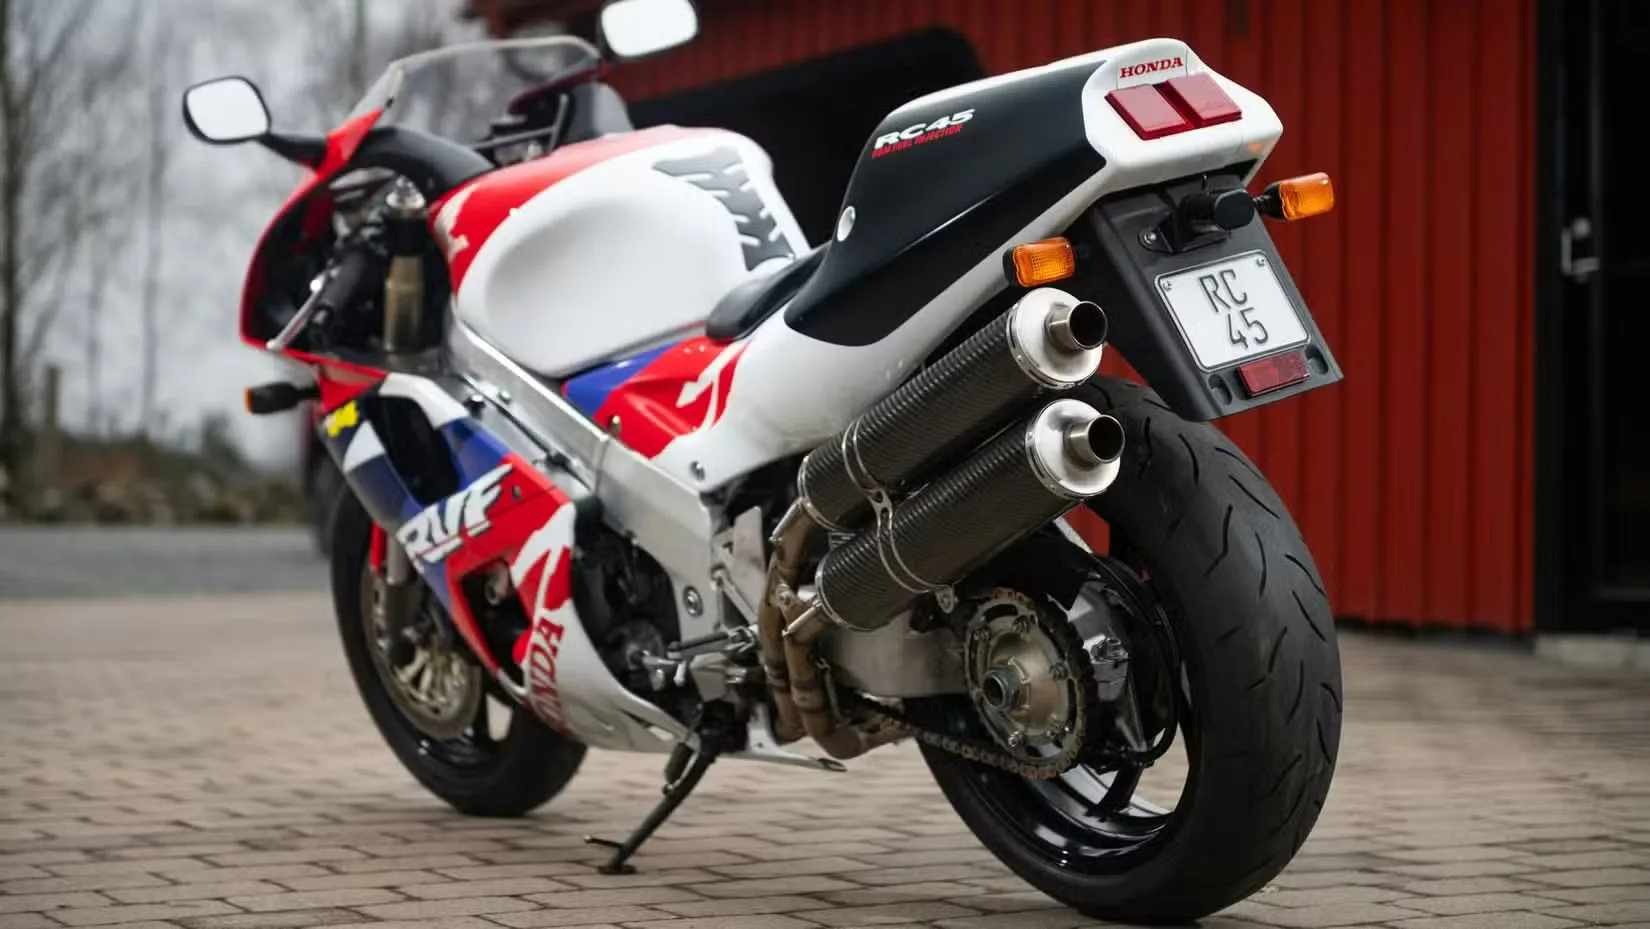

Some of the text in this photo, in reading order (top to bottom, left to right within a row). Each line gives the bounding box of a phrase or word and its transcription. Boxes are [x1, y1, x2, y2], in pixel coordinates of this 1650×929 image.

[1120, 57, 1183, 78] HONDA
[874, 108, 976, 150] RC45
[1199, 268, 1248, 313] RC
[1227, 307, 1268, 348] 45
[396, 463, 513, 573] RVF
